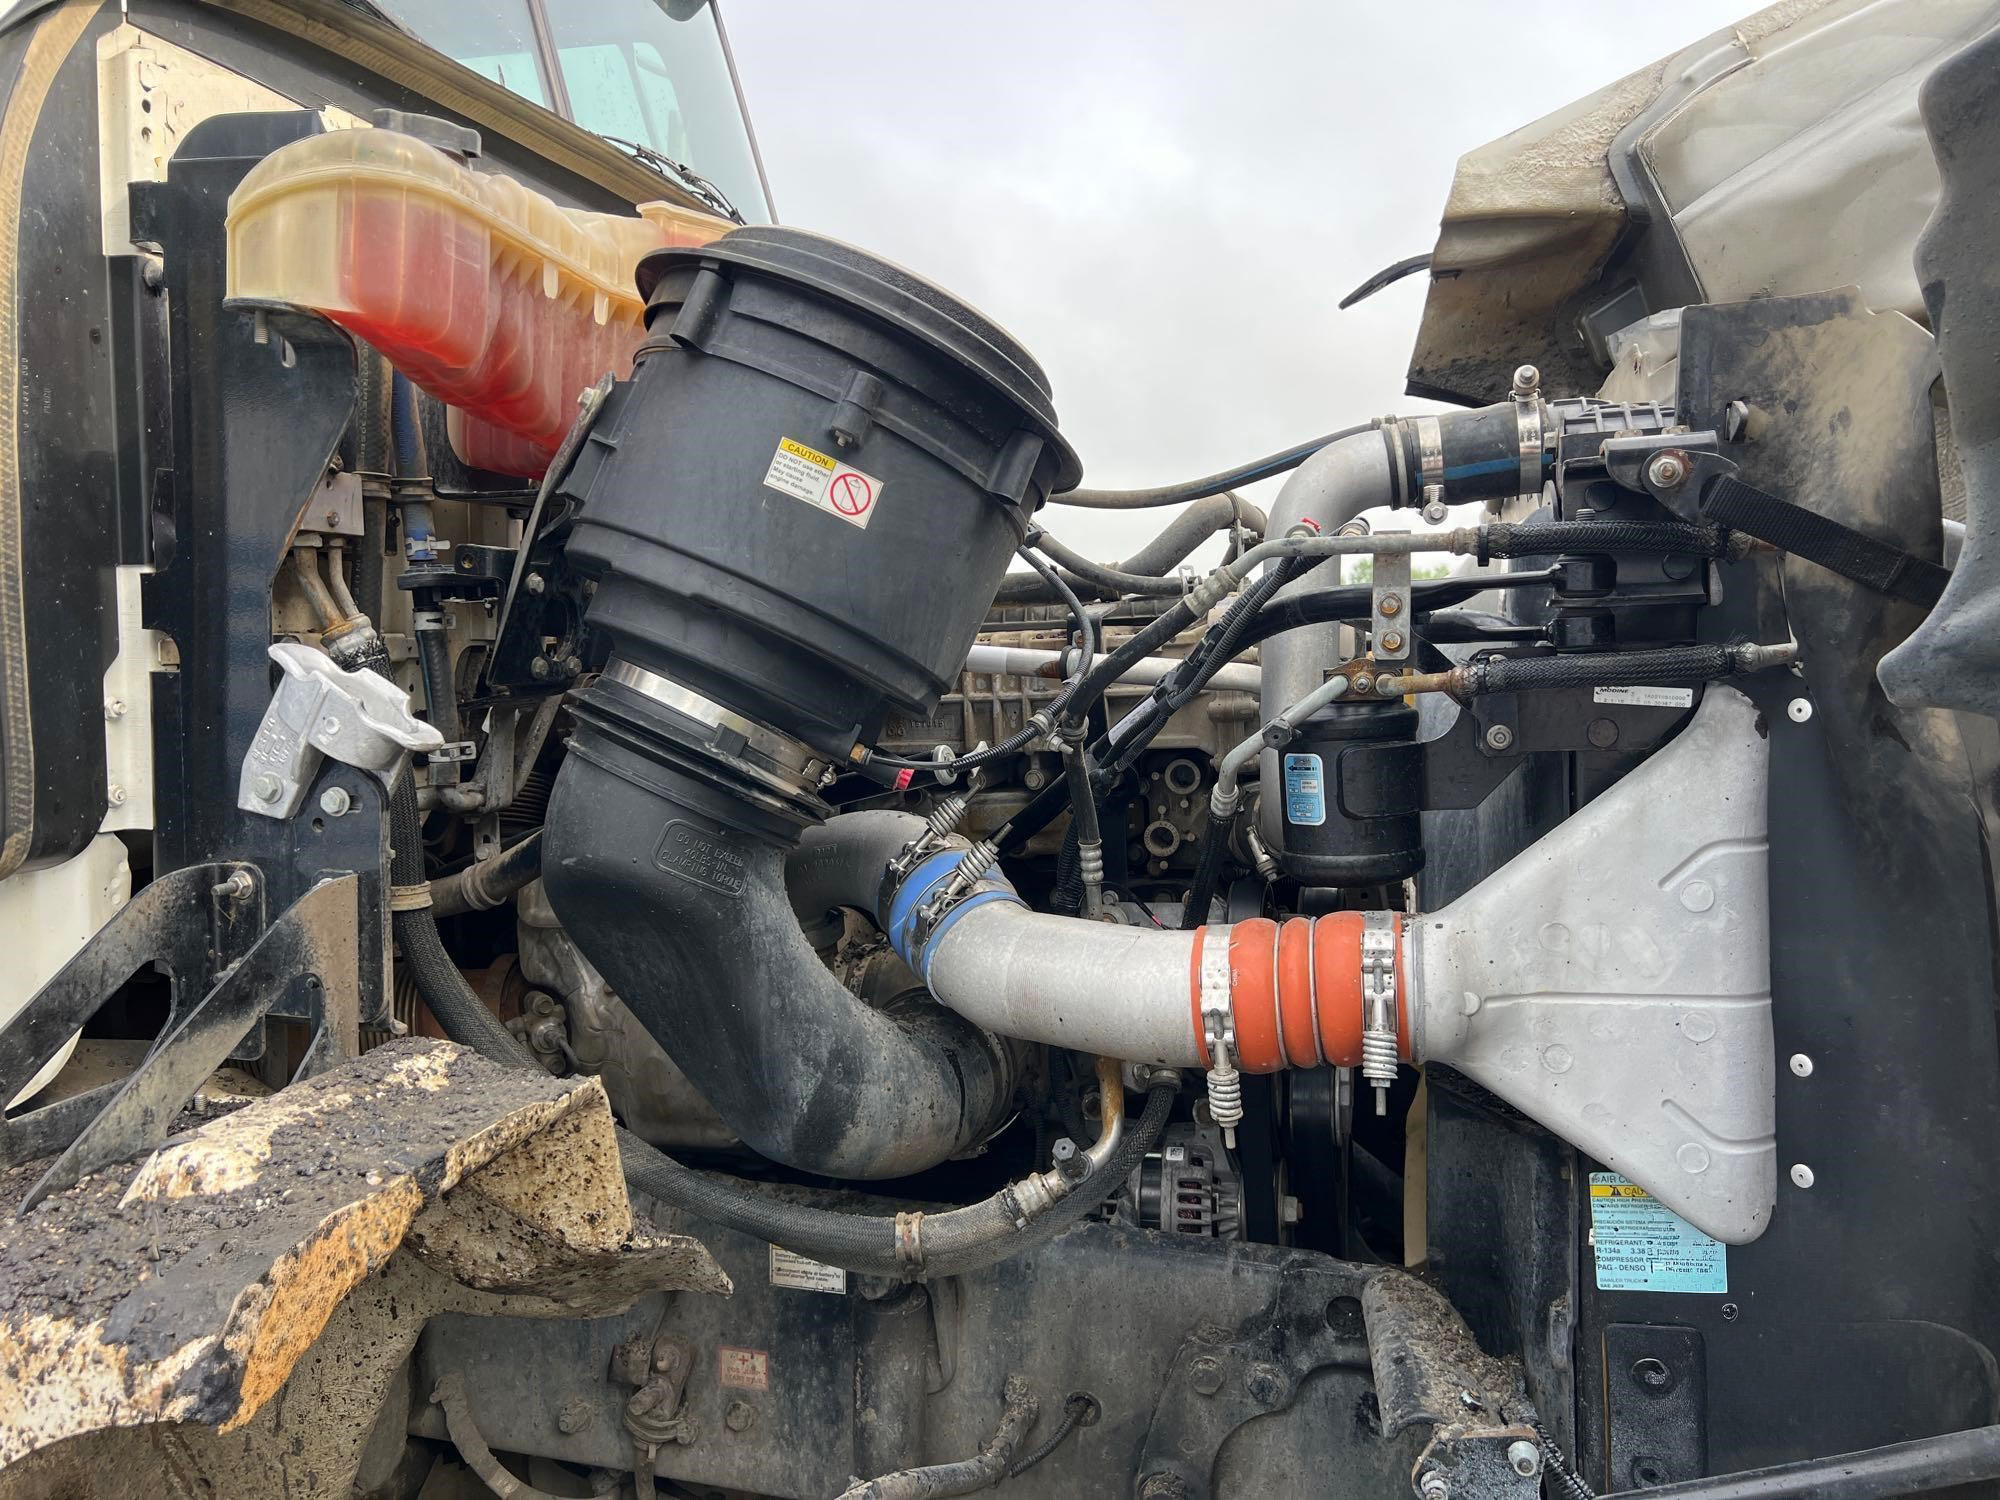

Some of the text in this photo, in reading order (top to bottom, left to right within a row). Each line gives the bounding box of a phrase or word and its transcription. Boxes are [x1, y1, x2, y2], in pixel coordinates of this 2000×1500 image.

[778, 452, 788, 461] DO
[788, 457, 802, 466] NOT
[802, 463, 813, 472] use
[788, 443, 829, 467] CAUTION
[772, 465, 803, 483] May cause
[782, 462, 805, 477] starting
[770, 473, 789, 485] engine
[676, 832, 744, 868] DO NOT EXCEED
[660, 850, 742, 890] CLAMPING TORQUE
[1600, 1175, 1616, 1183] AIR
[1618, 1264, 1646, 1272] DENSO
